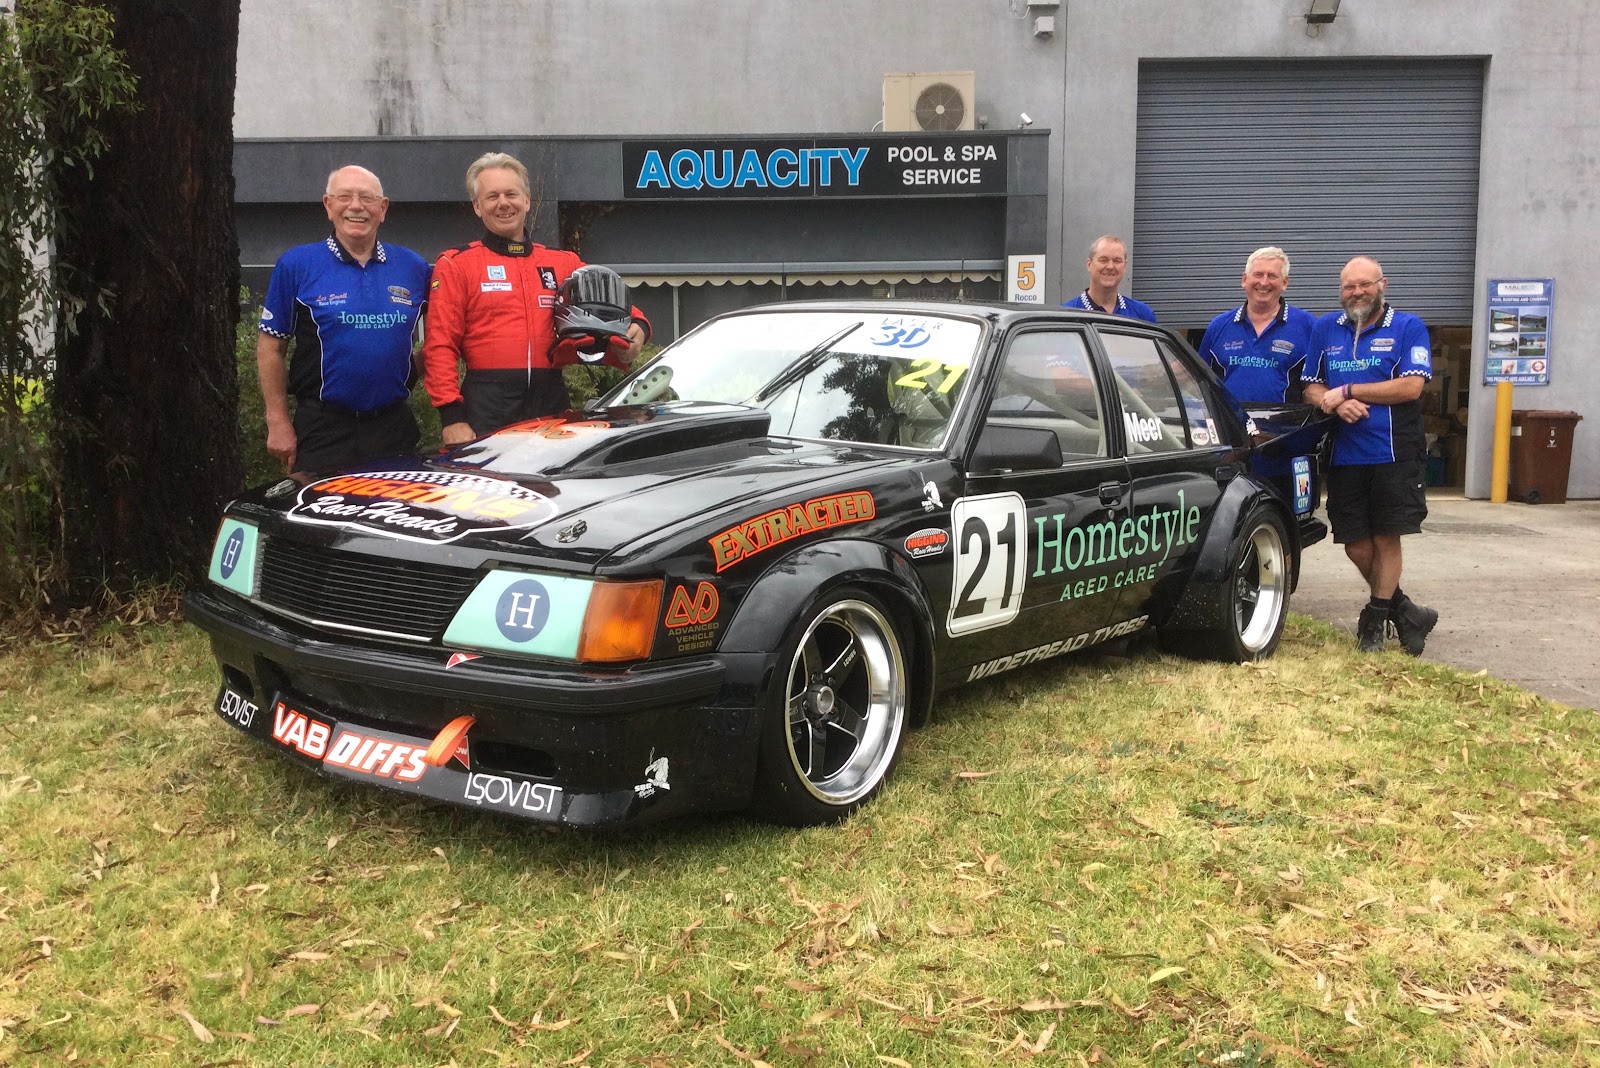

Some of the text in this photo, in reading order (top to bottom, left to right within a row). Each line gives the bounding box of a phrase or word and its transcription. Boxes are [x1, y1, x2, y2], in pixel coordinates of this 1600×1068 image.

[637, 147, 870, 190] AQUACITY
[888, 144, 998, 163] POOL & SPA
[902, 167, 981, 185] SERVICE
[1017, 261, 1036, 291] 5
[1014, 293, 1038, 301] Rocco
[338, 309, 408, 327] Homestyle
[895, 358, 969, 394] 21
[1123, 412, 1163, 443] Meer
[300, 495, 459, 534] Race Heads
[313, 475, 540, 519] HIGGINS
[1297, 497, 1309, 509] CITY
[709, 491, 876, 573] EXTRACTED
[907, 533, 947, 549] HIGGINS
[1032, 488, 1201, 578] Homestyle
[223, 538, 241, 569] H
[952, 515, 1016, 620] 21
[1060, 563, 1156, 602] AGED CARE
[505, 592, 540, 629] H
[668, 622, 720, 637] ADVANCED
[676, 631, 715, 644] VEHICLE
[678, 640, 713, 652] DESIGN
[966, 614, 1150, 683] WIDETREAD TYRES
[220, 688, 259, 728] ISOVIST
[271, 702, 430, 782] VAB DIFFS
[464, 772, 564, 813] ISOVIST
